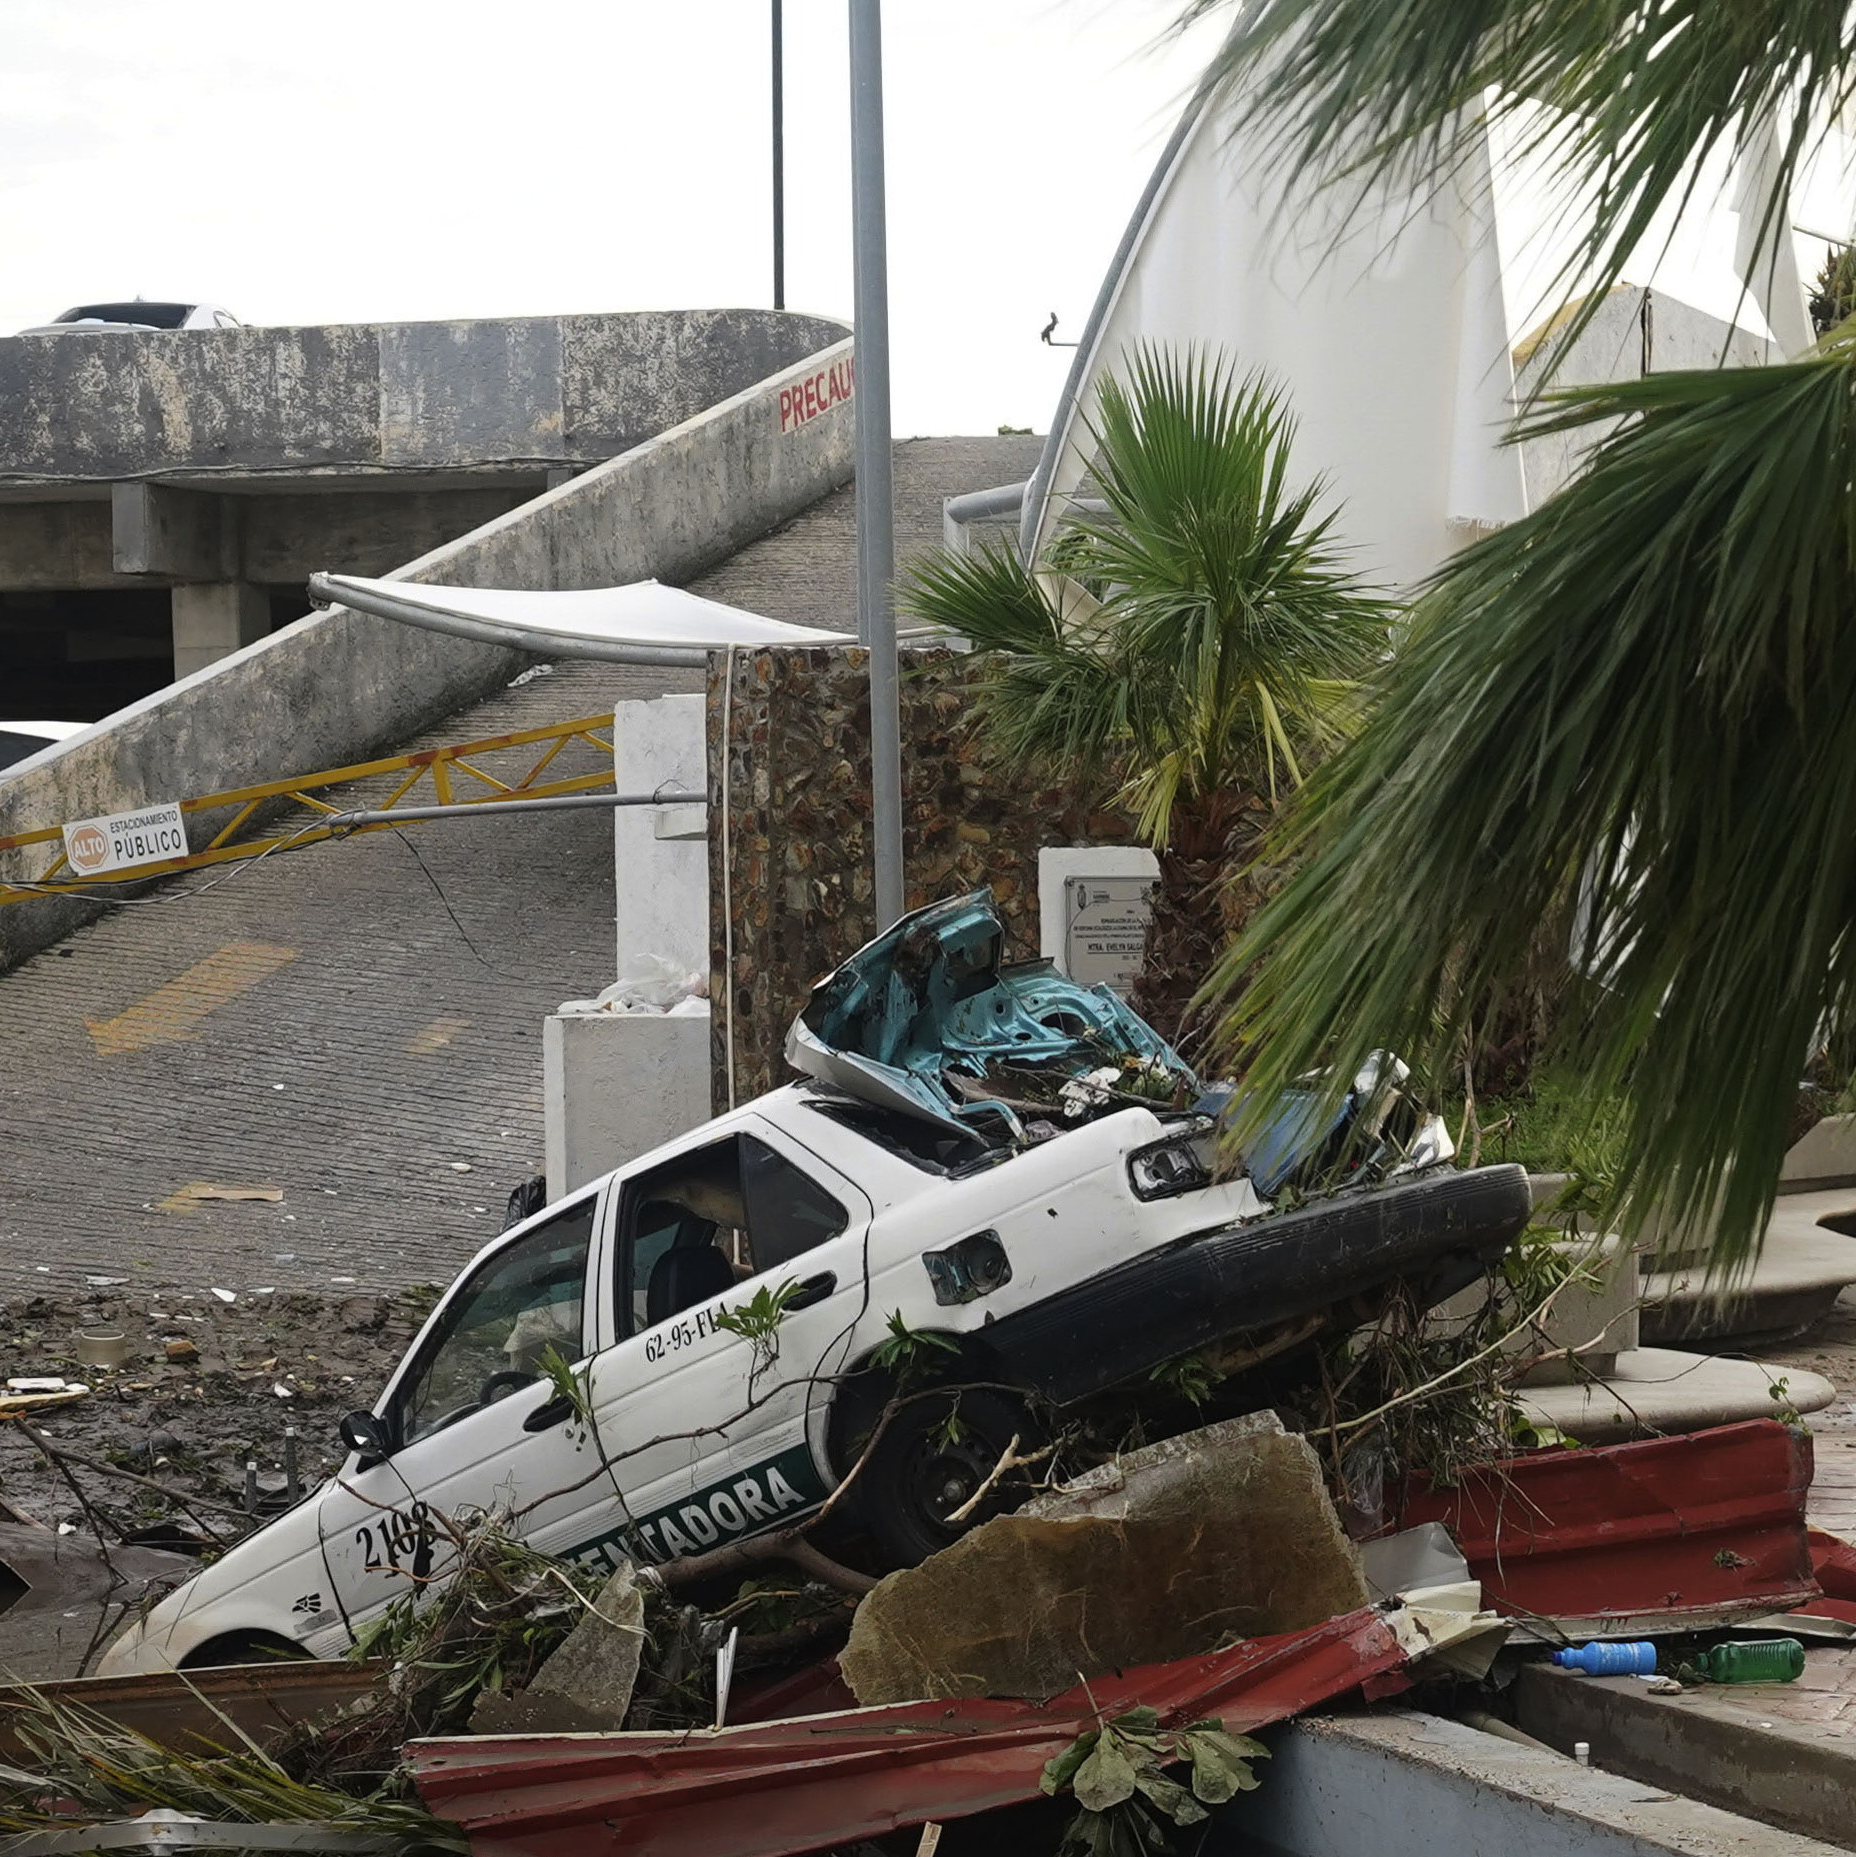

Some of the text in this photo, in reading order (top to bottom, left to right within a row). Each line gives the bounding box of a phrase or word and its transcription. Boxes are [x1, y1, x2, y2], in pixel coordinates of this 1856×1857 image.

[779, 357, 855, 433] PRECAU
[74, 810, 178, 857] ALTO ESTACIONAMIENTO
[114, 828, 182, 861] PÚBLICO
